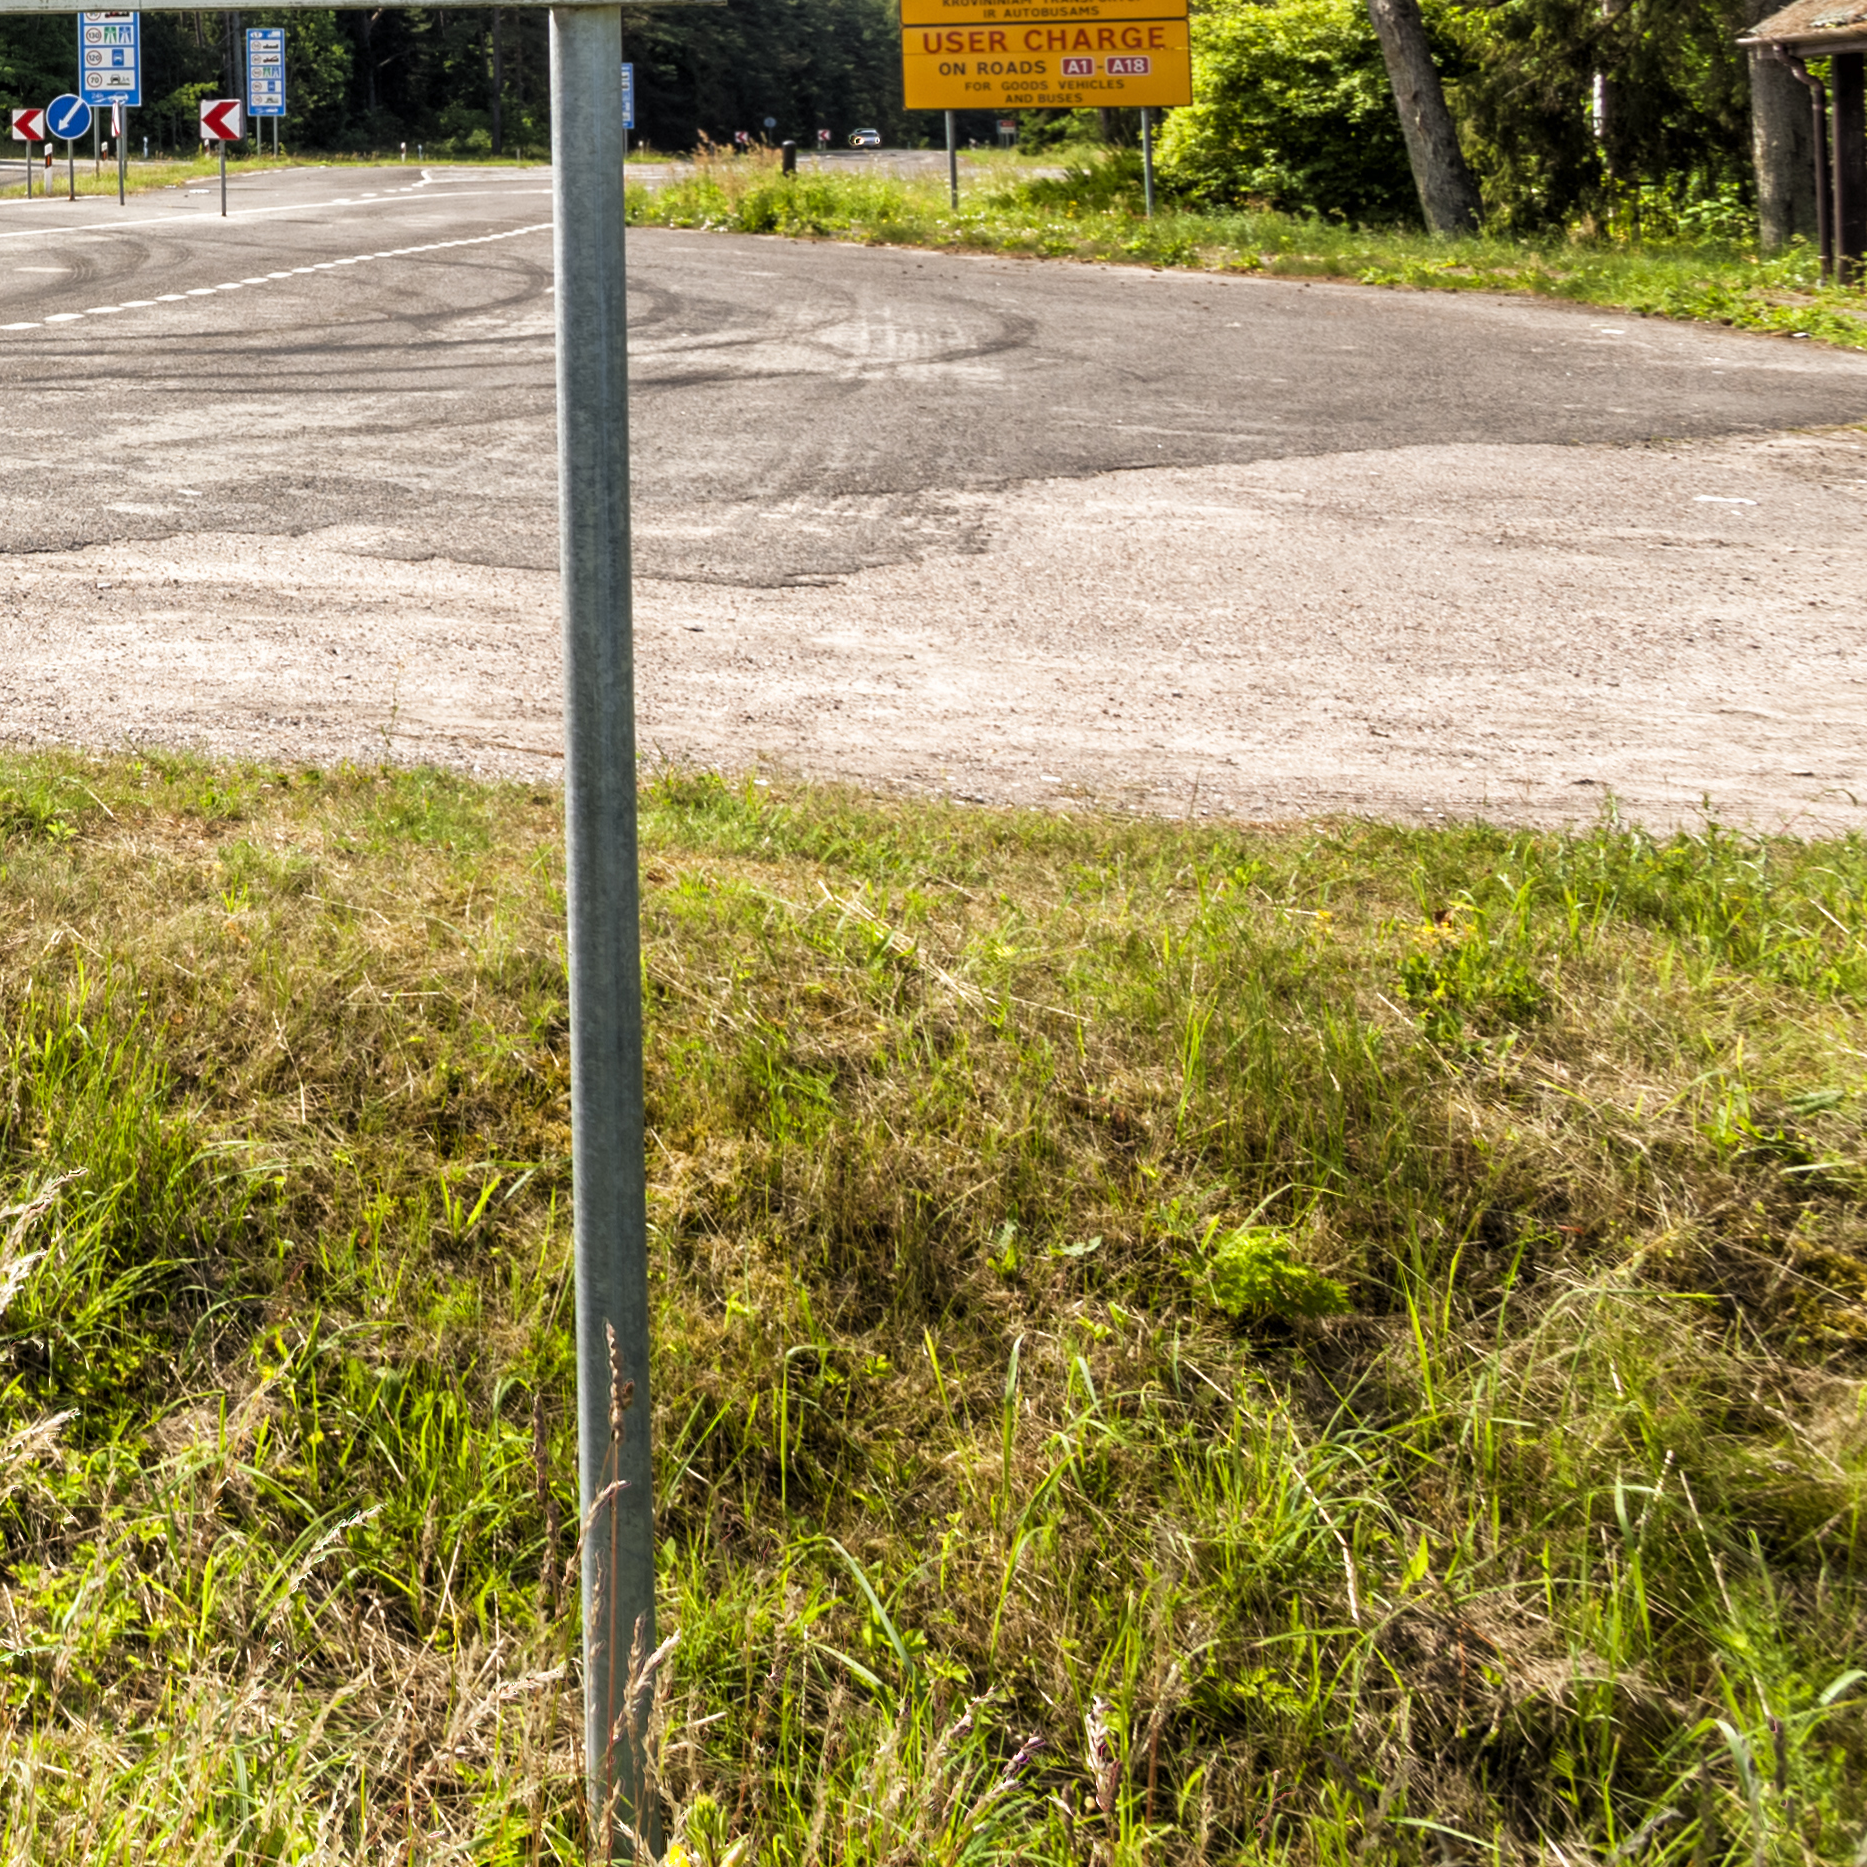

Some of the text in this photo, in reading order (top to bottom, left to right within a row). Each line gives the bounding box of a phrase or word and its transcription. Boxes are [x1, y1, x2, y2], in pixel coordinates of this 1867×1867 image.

[983, 6, 1100, 18] IR AUTOBUSAMS
[88, 31, 100, 39] 130
[922, 27, 1166, 54] USER CHARGE
[938, 61, 966, 76] ON
[976, 60, 1047, 75] ROADS
[1067, 59, 1089, 73] A1
[1112, 58, 1145, 73] A18
[964, 79, 1125, 91] FOR GOODS VEHICLES
[1005, 92, 1083, 104] AND BUSES
